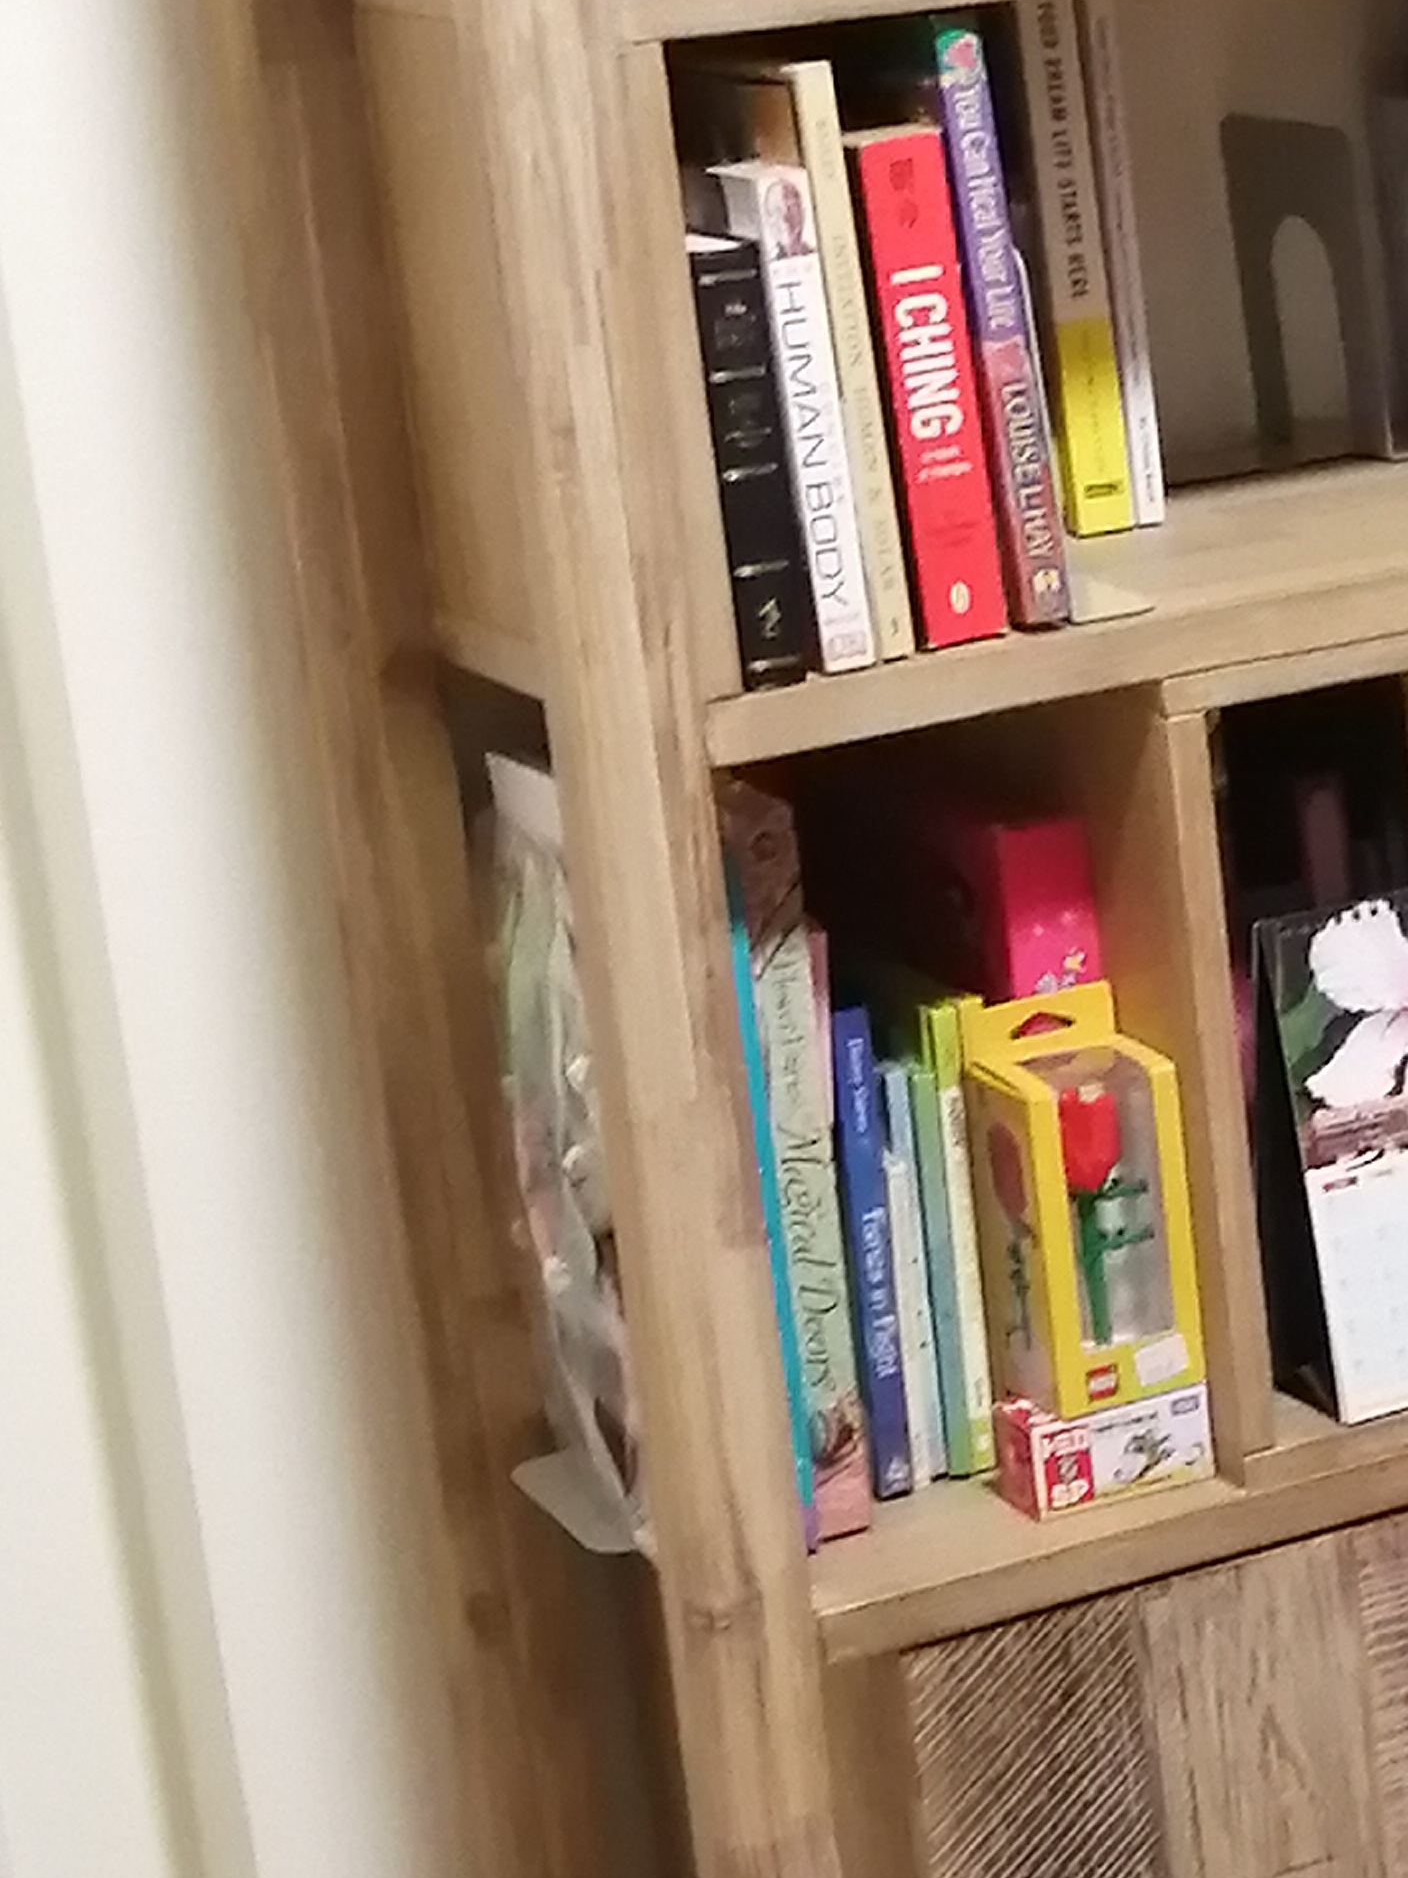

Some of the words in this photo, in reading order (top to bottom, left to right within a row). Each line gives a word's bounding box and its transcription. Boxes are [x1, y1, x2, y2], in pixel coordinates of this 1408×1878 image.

[1044, 57, 1067, 122] DREAM
[960, 130, 992, 176] Can
[1051, 129, 1073, 170] LIFE
[967, 175, 1002, 229] Heal
[1057, 178, 1083, 245] STARTS
[889, 264, 945, 286] I
[979, 228, 1008, 283] Your
[1066, 252, 1089, 300] HERE
[894, 292, 965, 441] CHING
[774, 279, 828, 469] HUMAN
[804, 483, 849, 608] BODY
[853, 386, 880, 472] HUMAN
[1001, 381, 1041, 484] LOUISE
[1022, 507, 1055, 557] HAY
[778, 1124, 838, 1270] Magical
[800, 1281, 838, 1394] Doors
